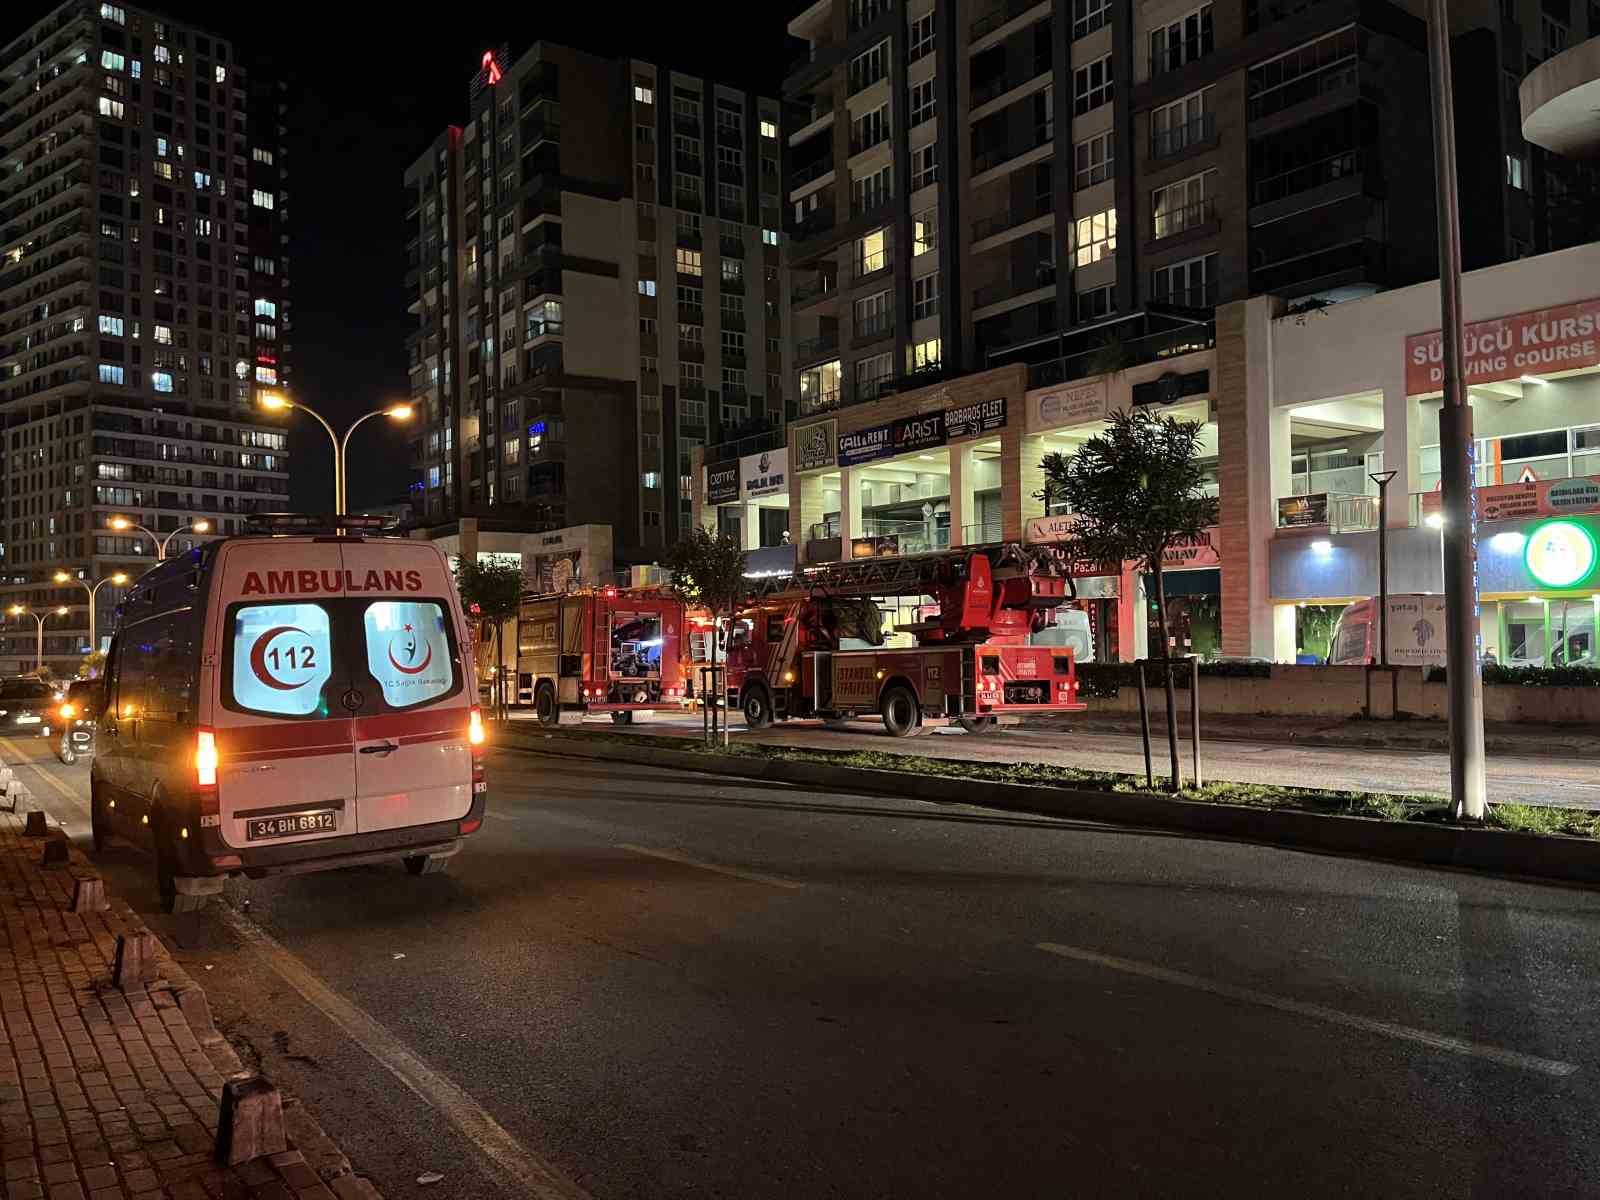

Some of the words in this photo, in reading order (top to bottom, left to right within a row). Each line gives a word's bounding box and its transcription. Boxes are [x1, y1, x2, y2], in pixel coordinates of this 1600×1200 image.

[1413, 325, 1514, 366] SÜÜCÜ
[1430, 357, 1508, 382] DVING
[1513, 340, 1597, 368] COURSE
[944, 404, 981, 427] BARBAROS
[982, 398, 1004, 418] FLEET
[868, 429, 889, 445] RENT
[242, 569, 423, 596] AMBULANS
[268, 645, 316, 671] 112
[257, 821, 276, 835] 34
[278, 818, 296, 833] BH
[299, 814, 333, 829] 6812
